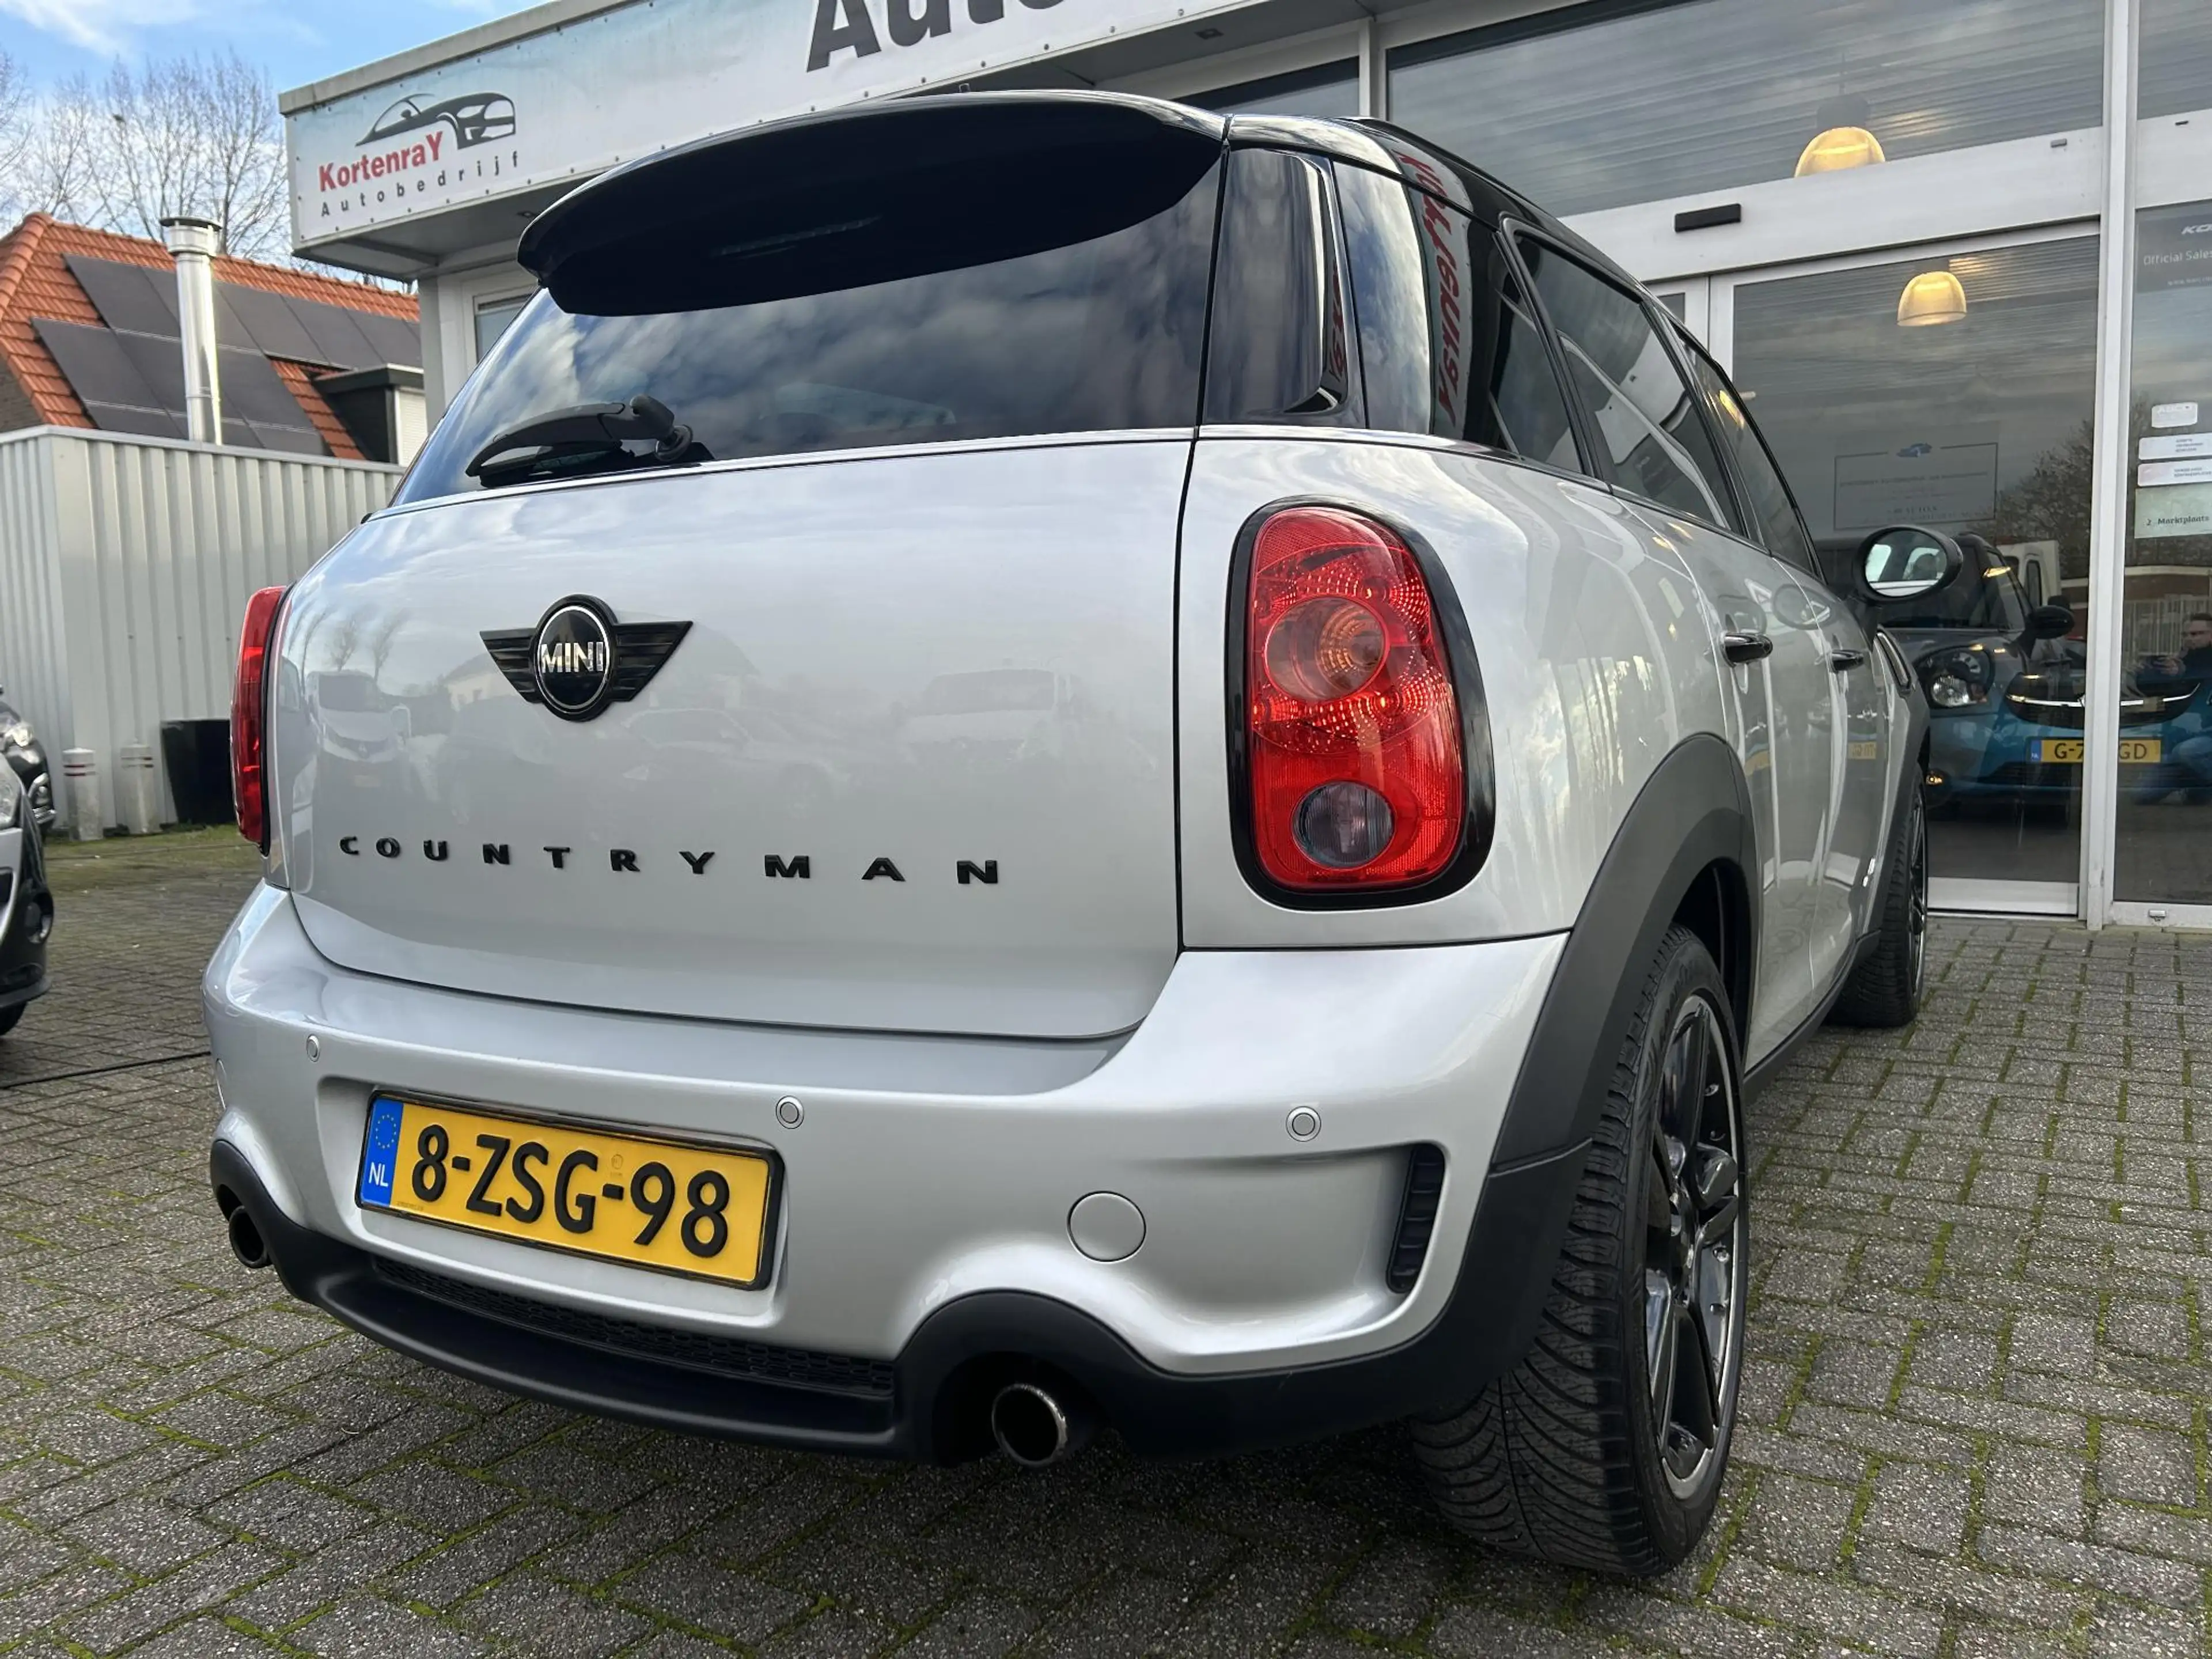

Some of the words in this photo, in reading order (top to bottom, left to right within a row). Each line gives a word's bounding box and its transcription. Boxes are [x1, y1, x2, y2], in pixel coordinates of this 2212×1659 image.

[318, 131, 443, 191] KortenraY
[320, 150, 518, 217] Autobedrijf
[541, 641, 604, 673] MINI
[339, 835, 998, 885] COUNTRYMAN
[368, 1161, 389, 1187] NL
[411, 1124, 730, 1258] 8-ZSG-98
